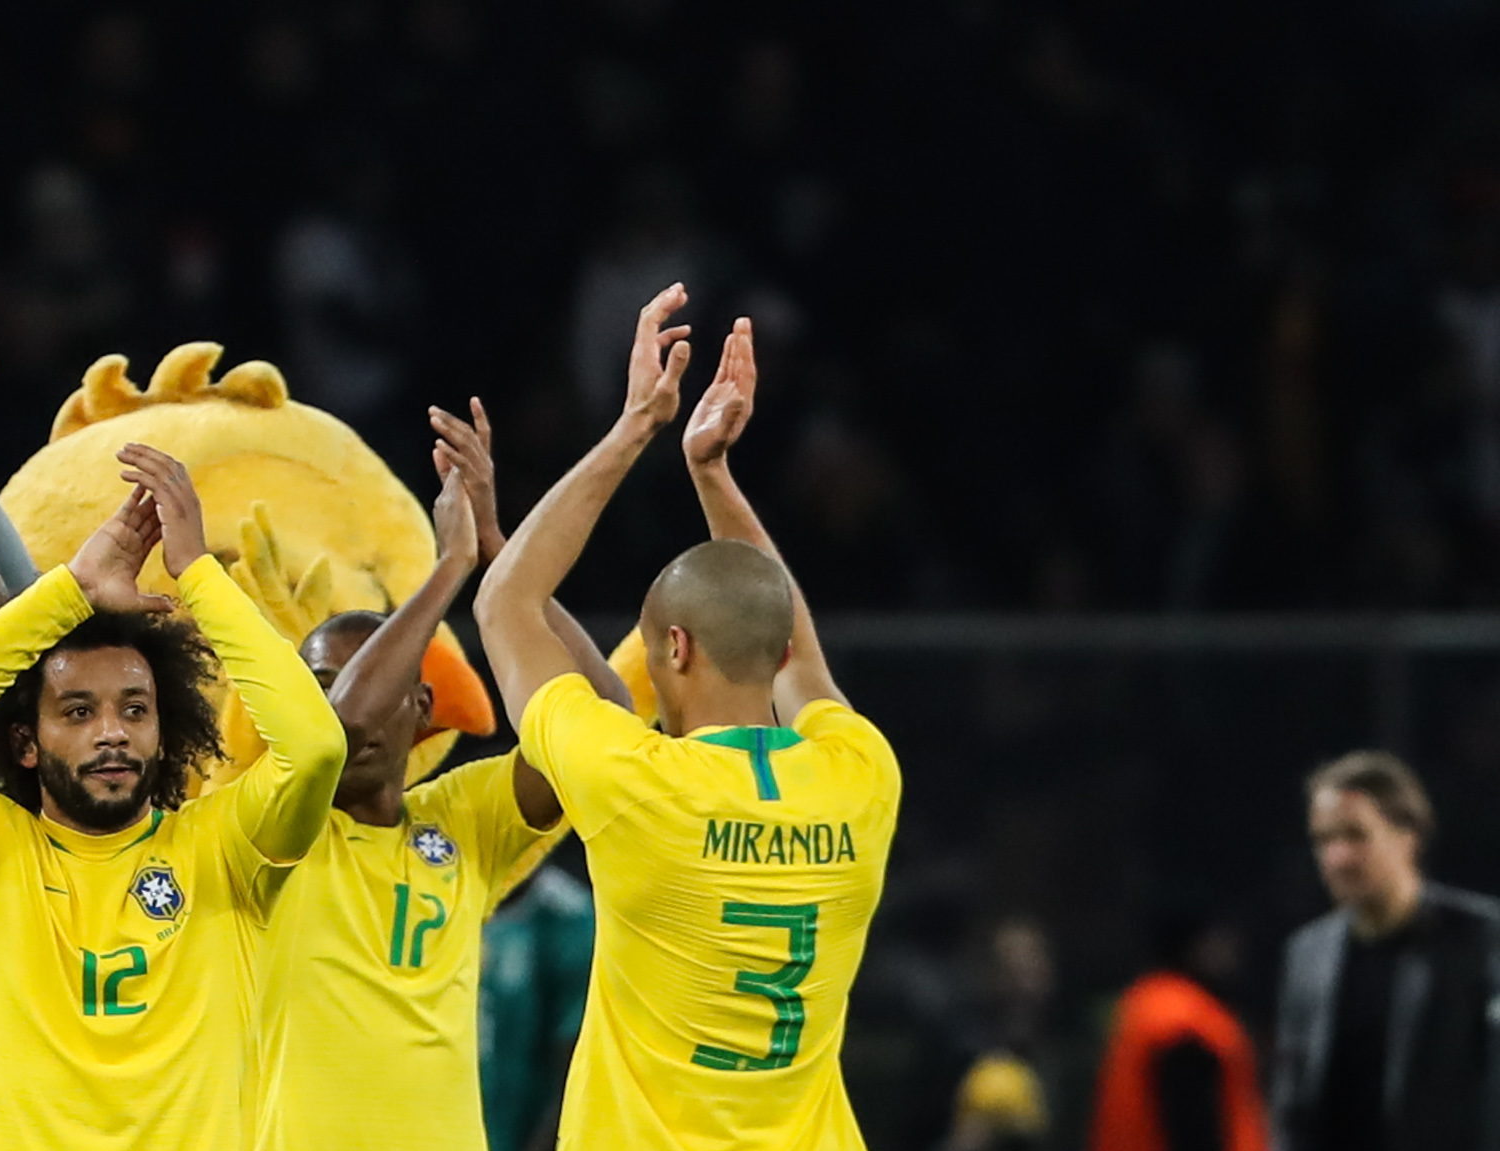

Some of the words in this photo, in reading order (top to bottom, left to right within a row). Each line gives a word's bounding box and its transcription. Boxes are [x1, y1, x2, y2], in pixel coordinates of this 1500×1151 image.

[703, 819, 856, 865] MIRANDA
[389, 883, 446, 968] 17
[79, 945, 149, 1017] 12
[690, 901, 819, 1072] 3
